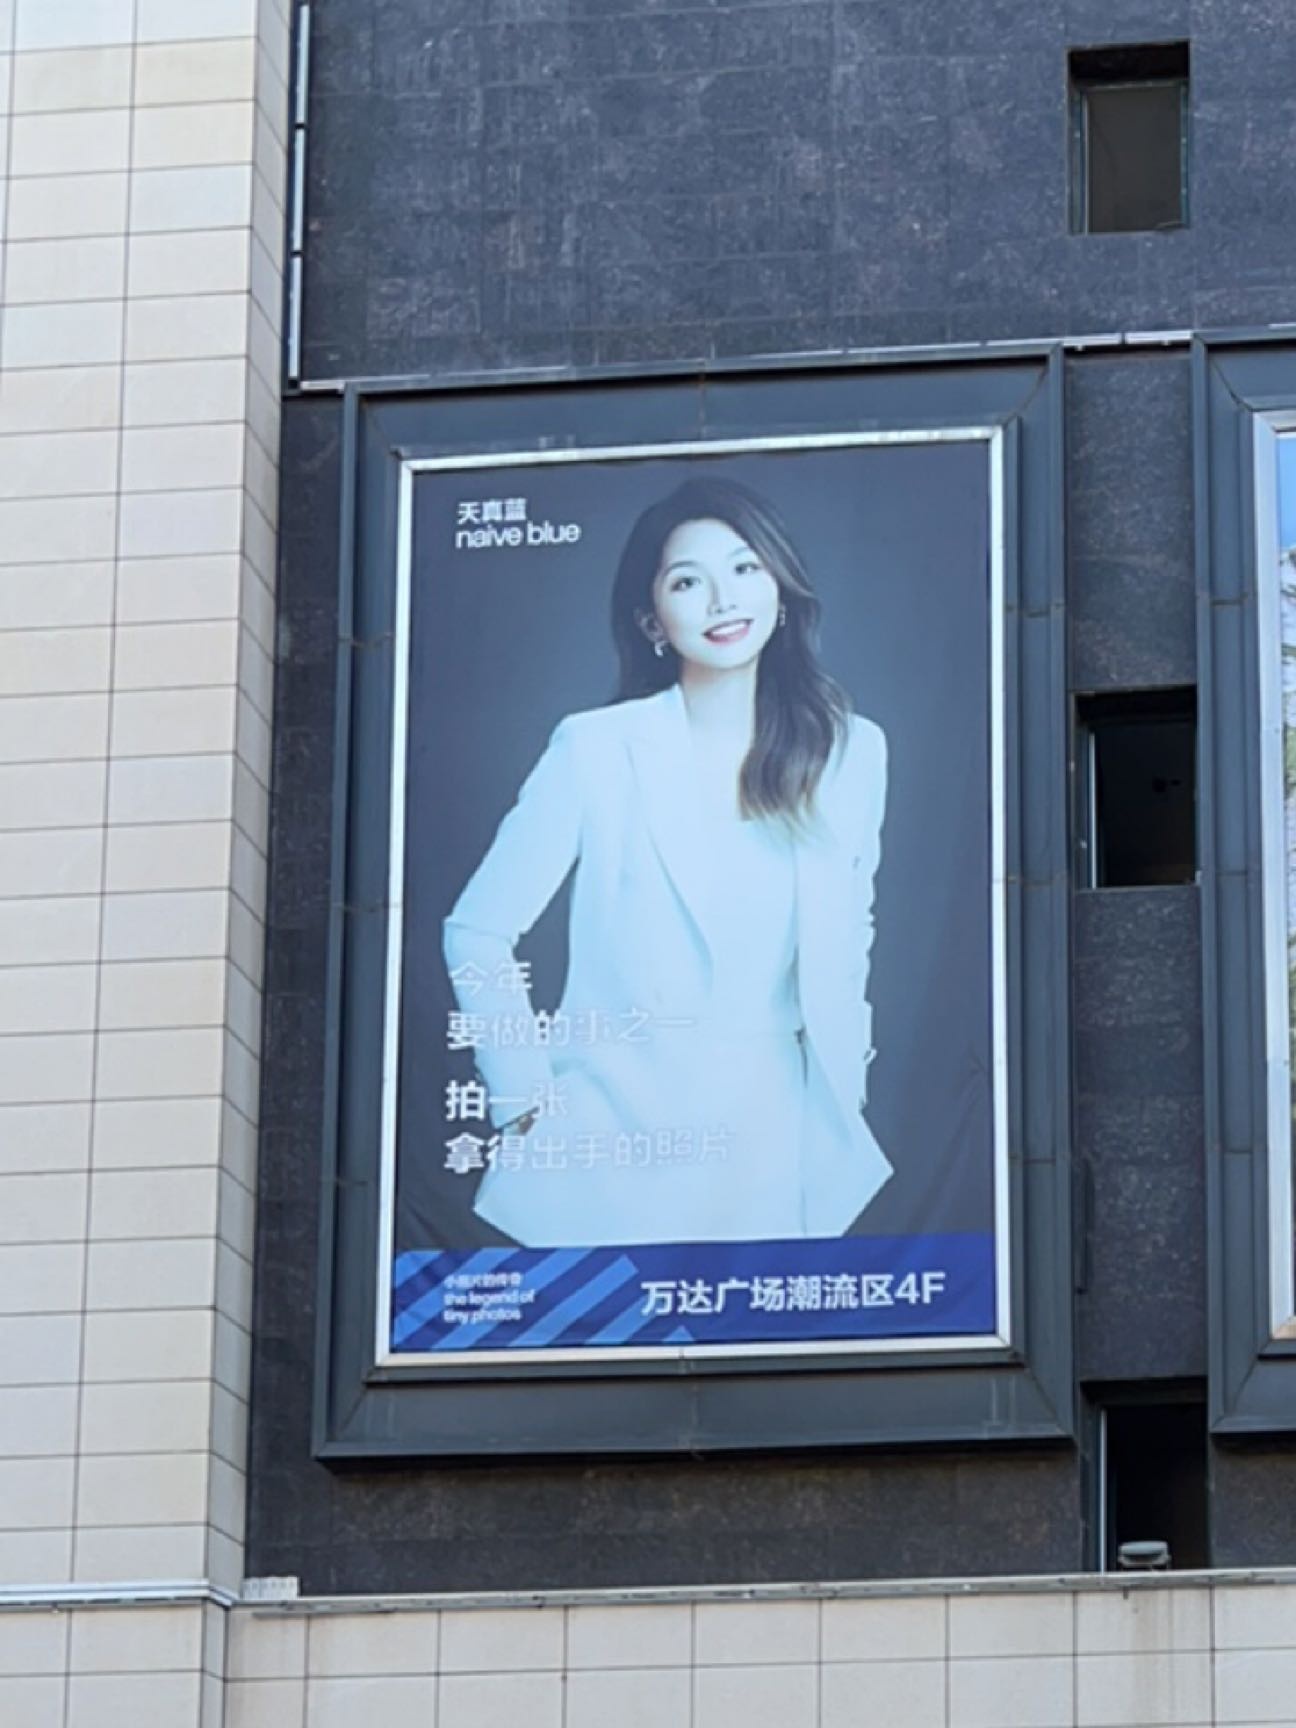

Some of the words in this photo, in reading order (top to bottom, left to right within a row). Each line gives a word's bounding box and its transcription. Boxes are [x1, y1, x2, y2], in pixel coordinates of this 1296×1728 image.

[457, 498, 527, 525] 天真蓝
[455, 524, 523, 549] naive
[526, 521, 582, 546] blue
[449, 960, 533, 996] 今年
[445, 1079, 568, 1122] 拍一张
[444, 1124, 736, 1175] 拿得出手的照片
[640, 1271, 947, 1317] 万达广场潮流区4F
